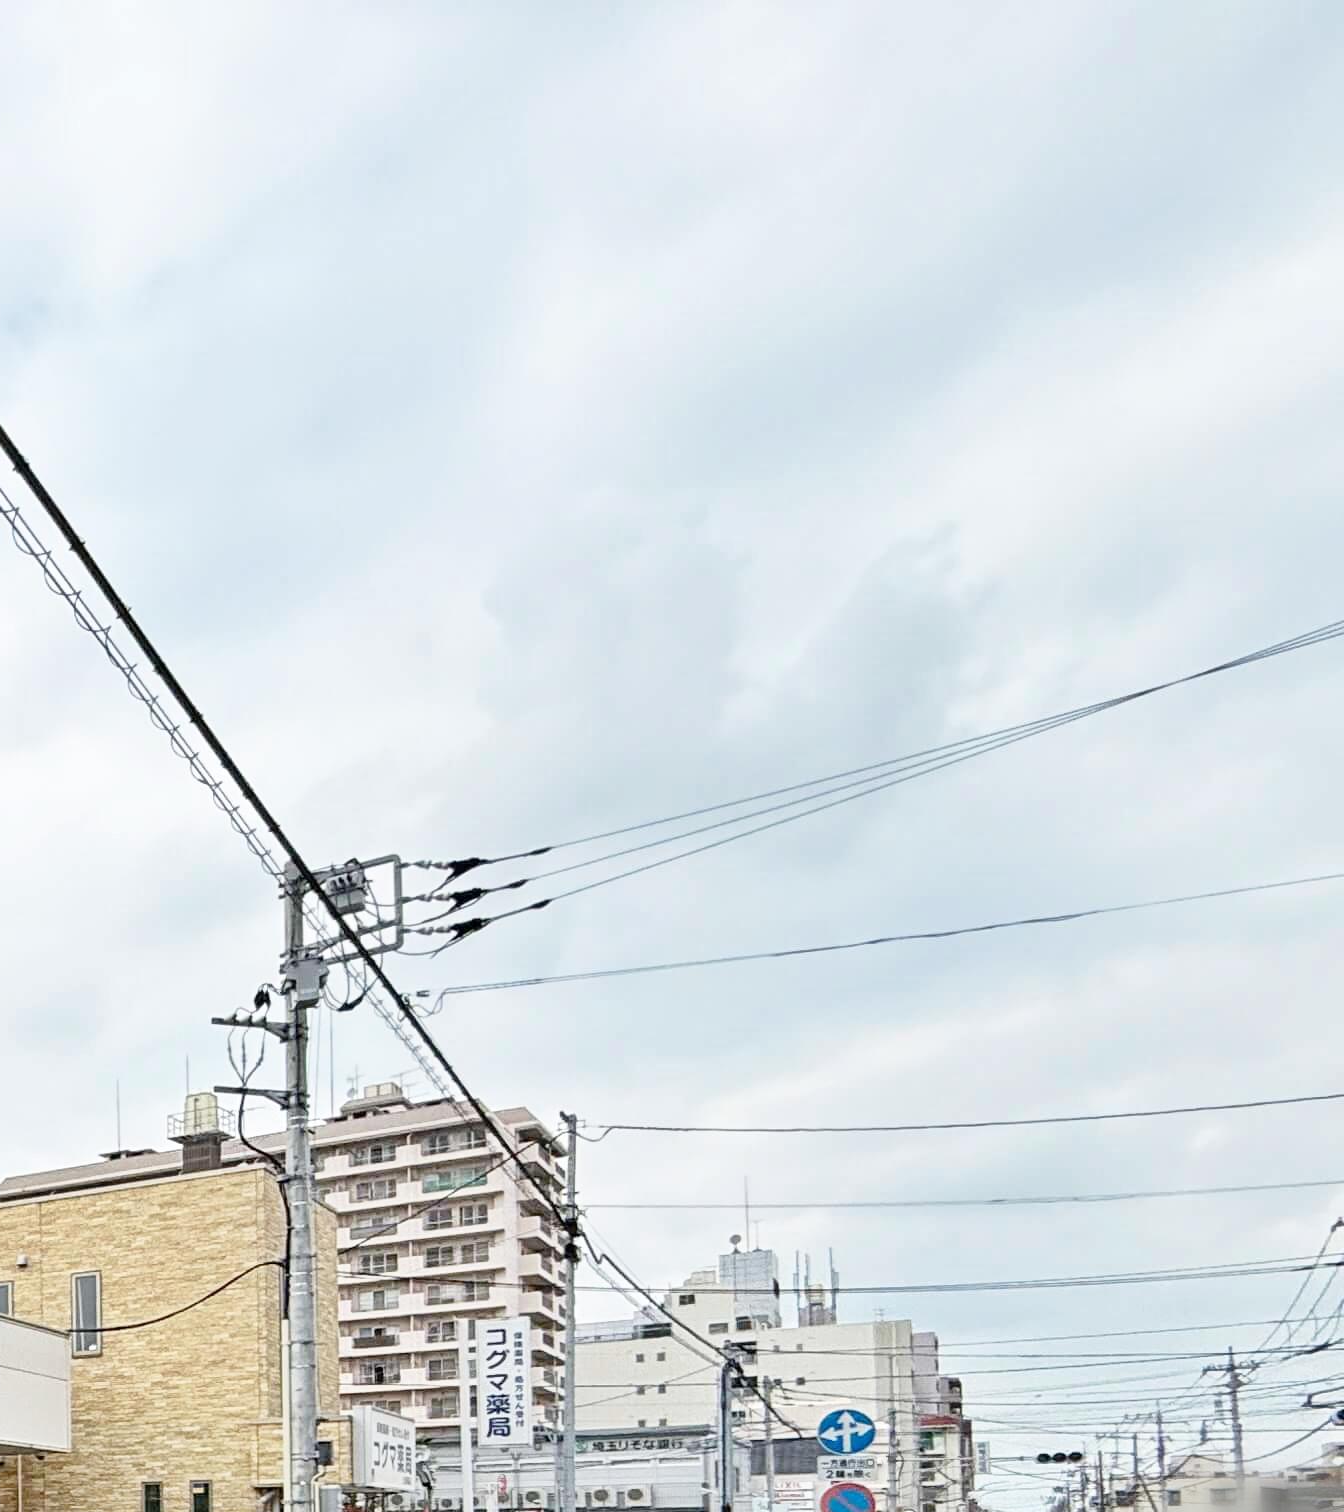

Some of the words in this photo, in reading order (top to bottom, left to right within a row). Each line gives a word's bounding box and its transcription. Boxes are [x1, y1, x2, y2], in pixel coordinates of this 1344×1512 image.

[486, 1328, 511, 1438] コグマ薬局
[374, 1441, 411, 1475] コグマ薬局
[592, 1440, 683, 1450] 埼玉りそな銀行
